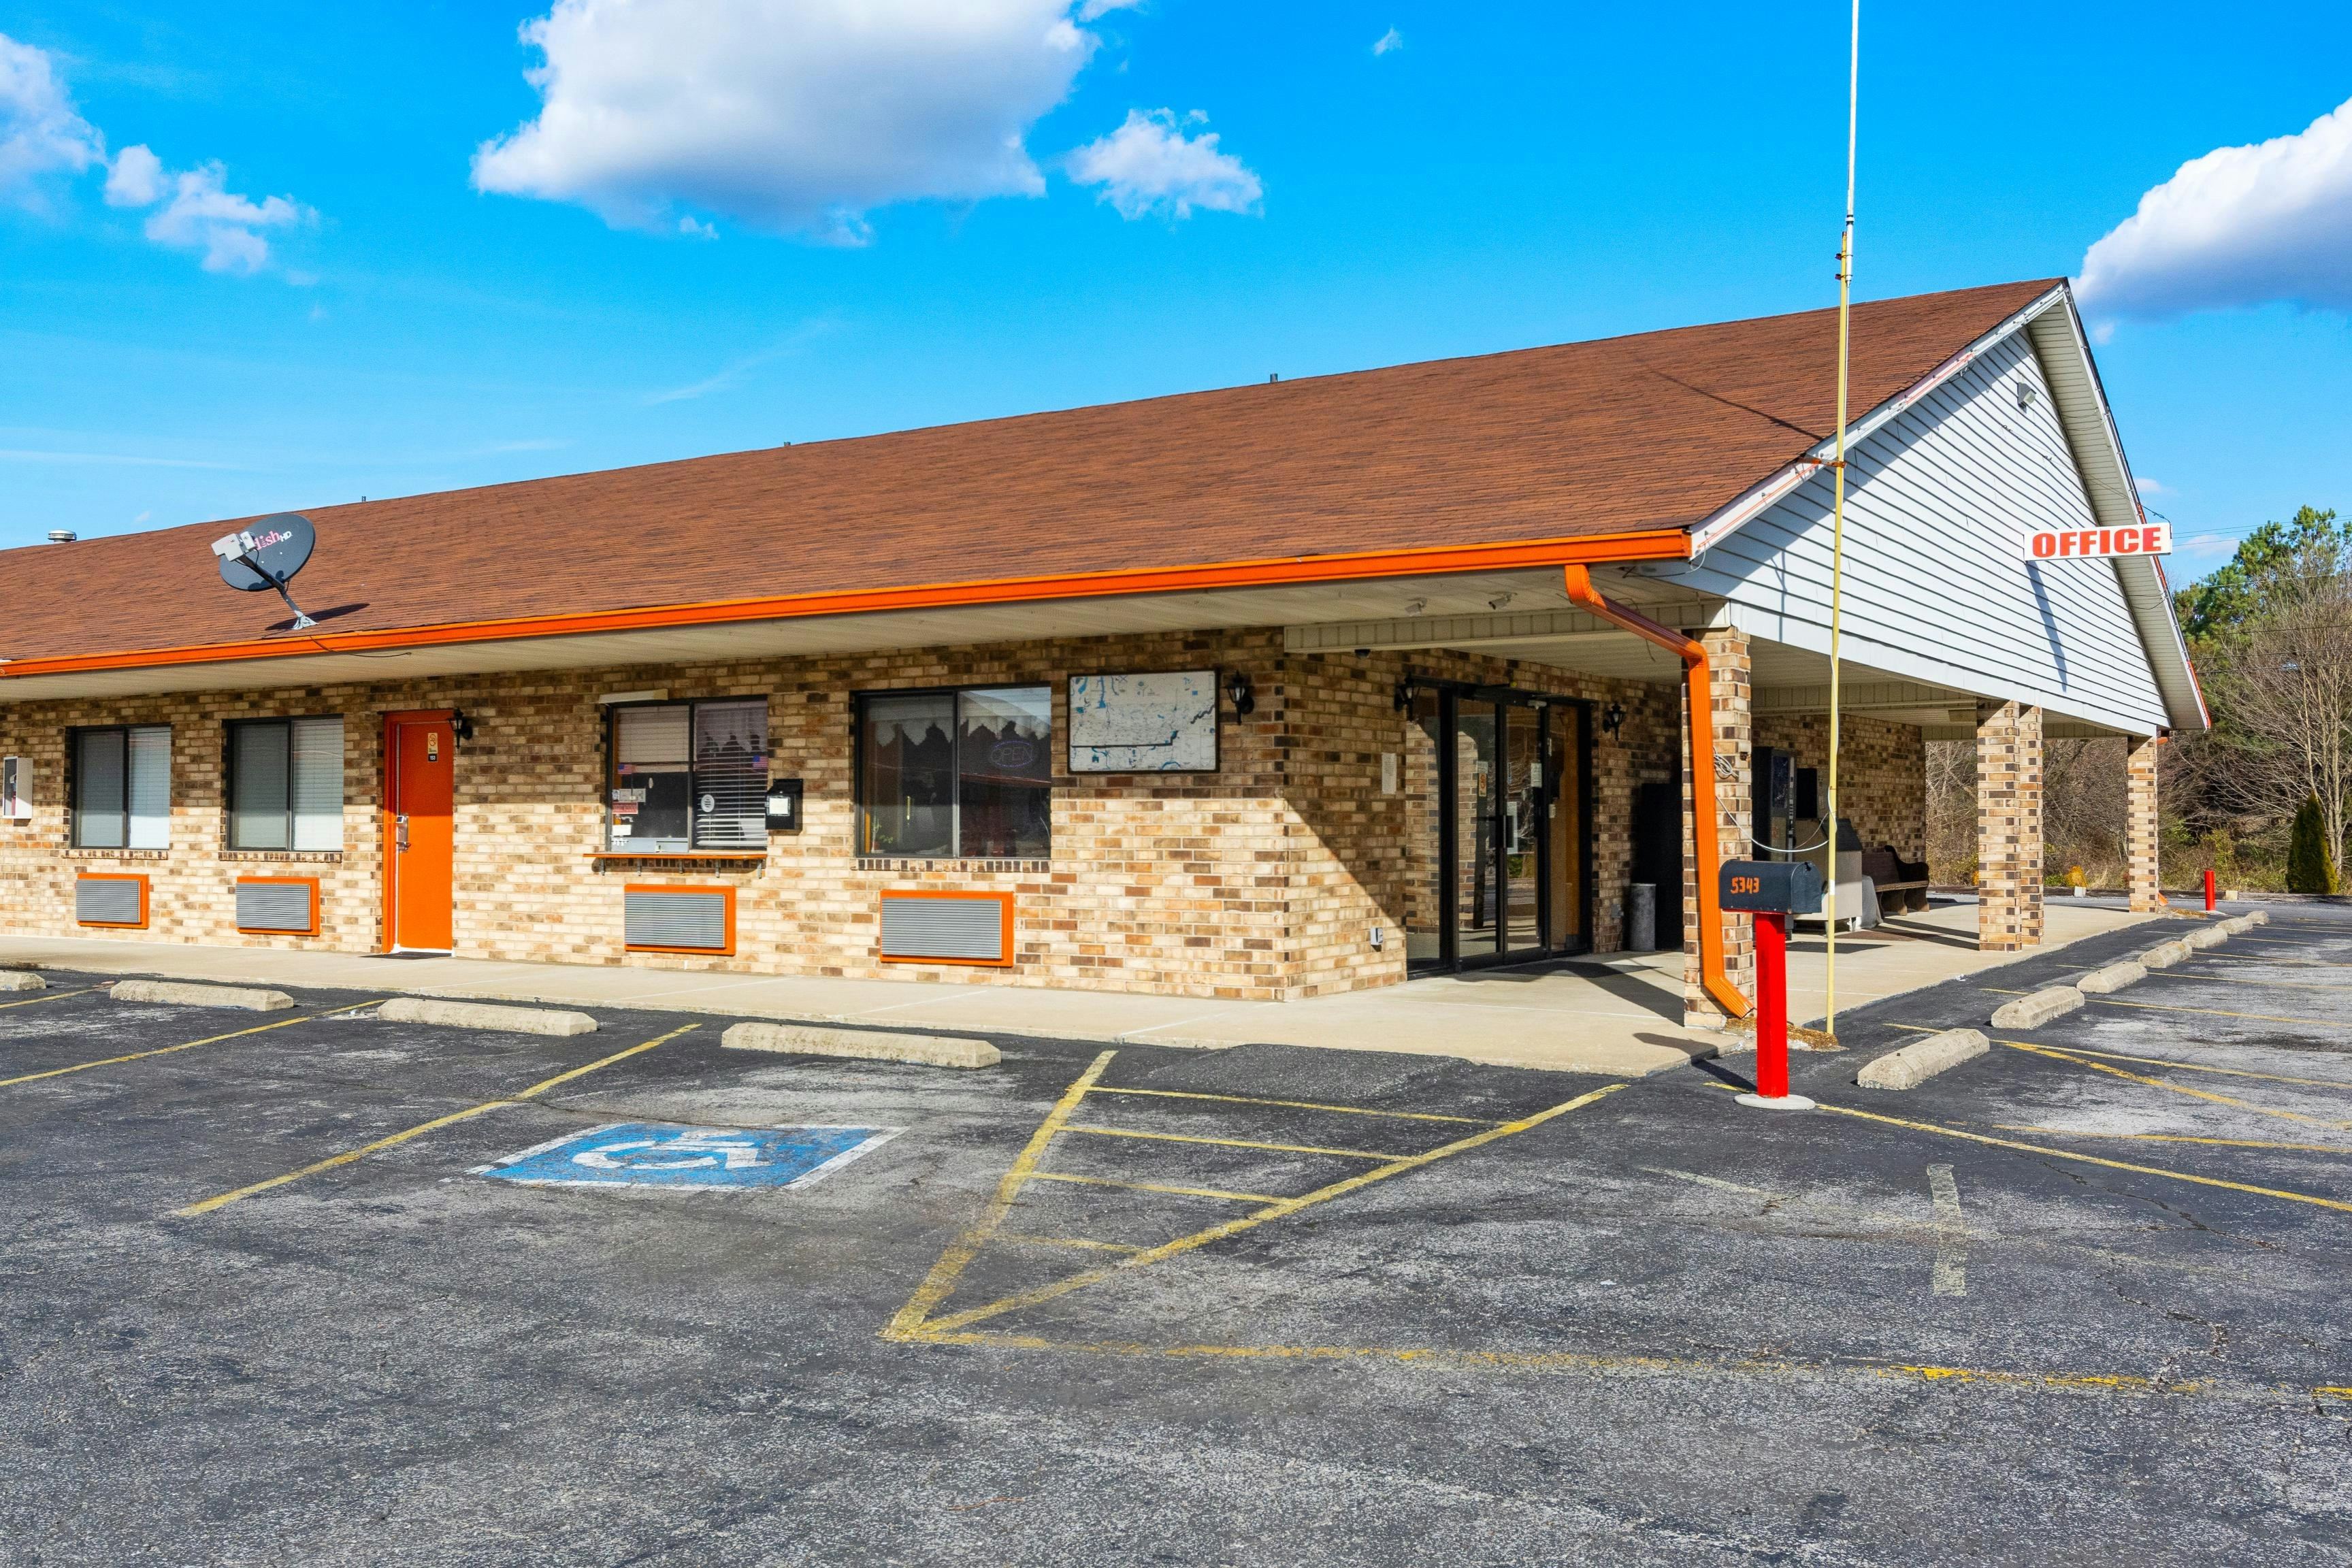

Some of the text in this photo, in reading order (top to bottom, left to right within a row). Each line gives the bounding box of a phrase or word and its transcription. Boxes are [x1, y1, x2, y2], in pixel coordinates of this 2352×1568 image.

[2033, 527, 2161, 557] OFFICE
[991, 747, 1033, 762] OPEN
[1731, 877, 1759, 894] 5343
